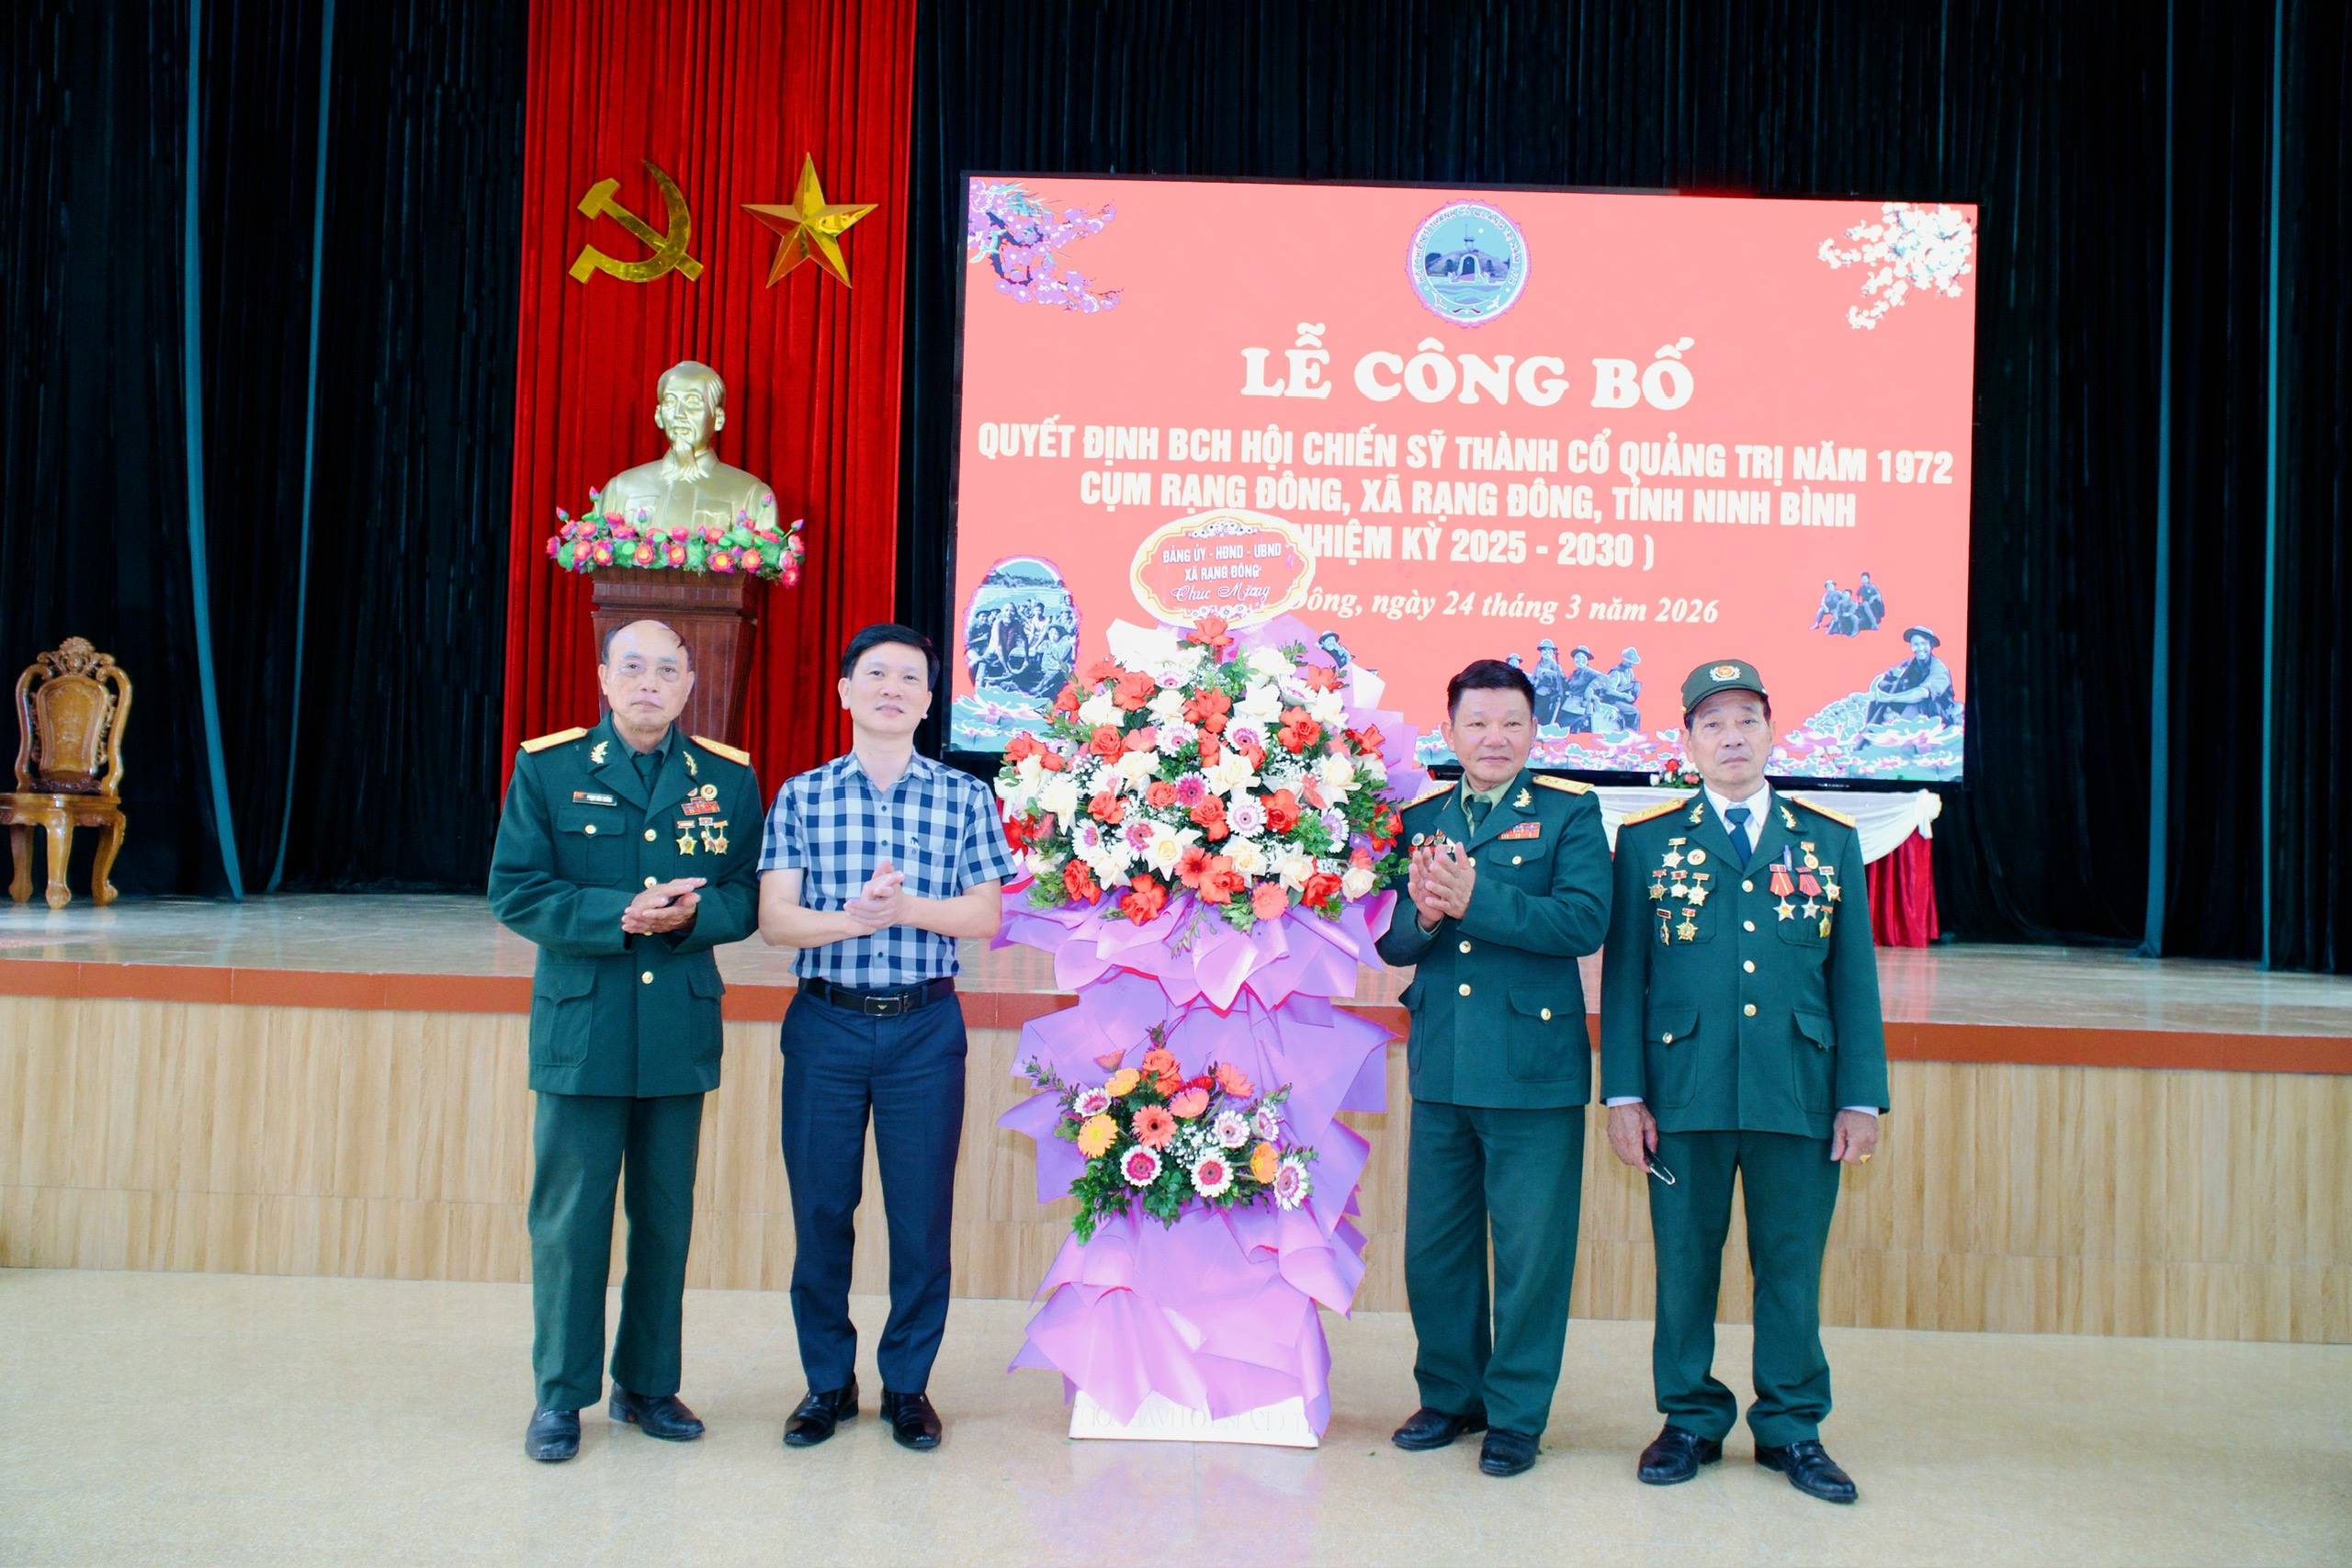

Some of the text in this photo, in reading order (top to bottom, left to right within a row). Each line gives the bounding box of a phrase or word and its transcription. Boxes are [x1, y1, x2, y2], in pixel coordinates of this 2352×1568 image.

[1240, 321, 1695, 411] LỄ CÔNG BỐ
[978, 413, 1954, 487] QUYẾT ĐỊNH BCH HỘI CHIẾN SỸ THÀNH CỔ QUẢNG TRỊ NĂM 1972
[1080, 469, 1857, 527] CỤM RẠNG ĐÔNG, XÃ RẠNG ĐÔNG, TỈNH NINH BÌNH
[1162, 545, 1191, 563] ĐẢNG
[1193, 544, 1206, 562] ỦY
[1216, 544, 1244, 559] HĐND
[1254, 543, 1282, 558] UBND
[1401, 520, 1442, 561] KỲ
[1450, 528, 1527, 564] 2025
[1535, 545, 1549, 555] -
[1557, 531, 1634, 568] 2030
[1643, 534, 1655, 571] )
[1171, 584, 1211, 602] Chúc
[1184, 562, 1261, 582] XÃ RẠNG ĐÔNG
[1371, 589, 1436, 621] ngày
[1442, 590, 1476, 615] 24
[1481, 592, 1559, 626] tháng
[1565, 593, 1582, 619] 3
[1589, 596, 1647, 622] năm
[1654, 596, 1720, 624] 2026
